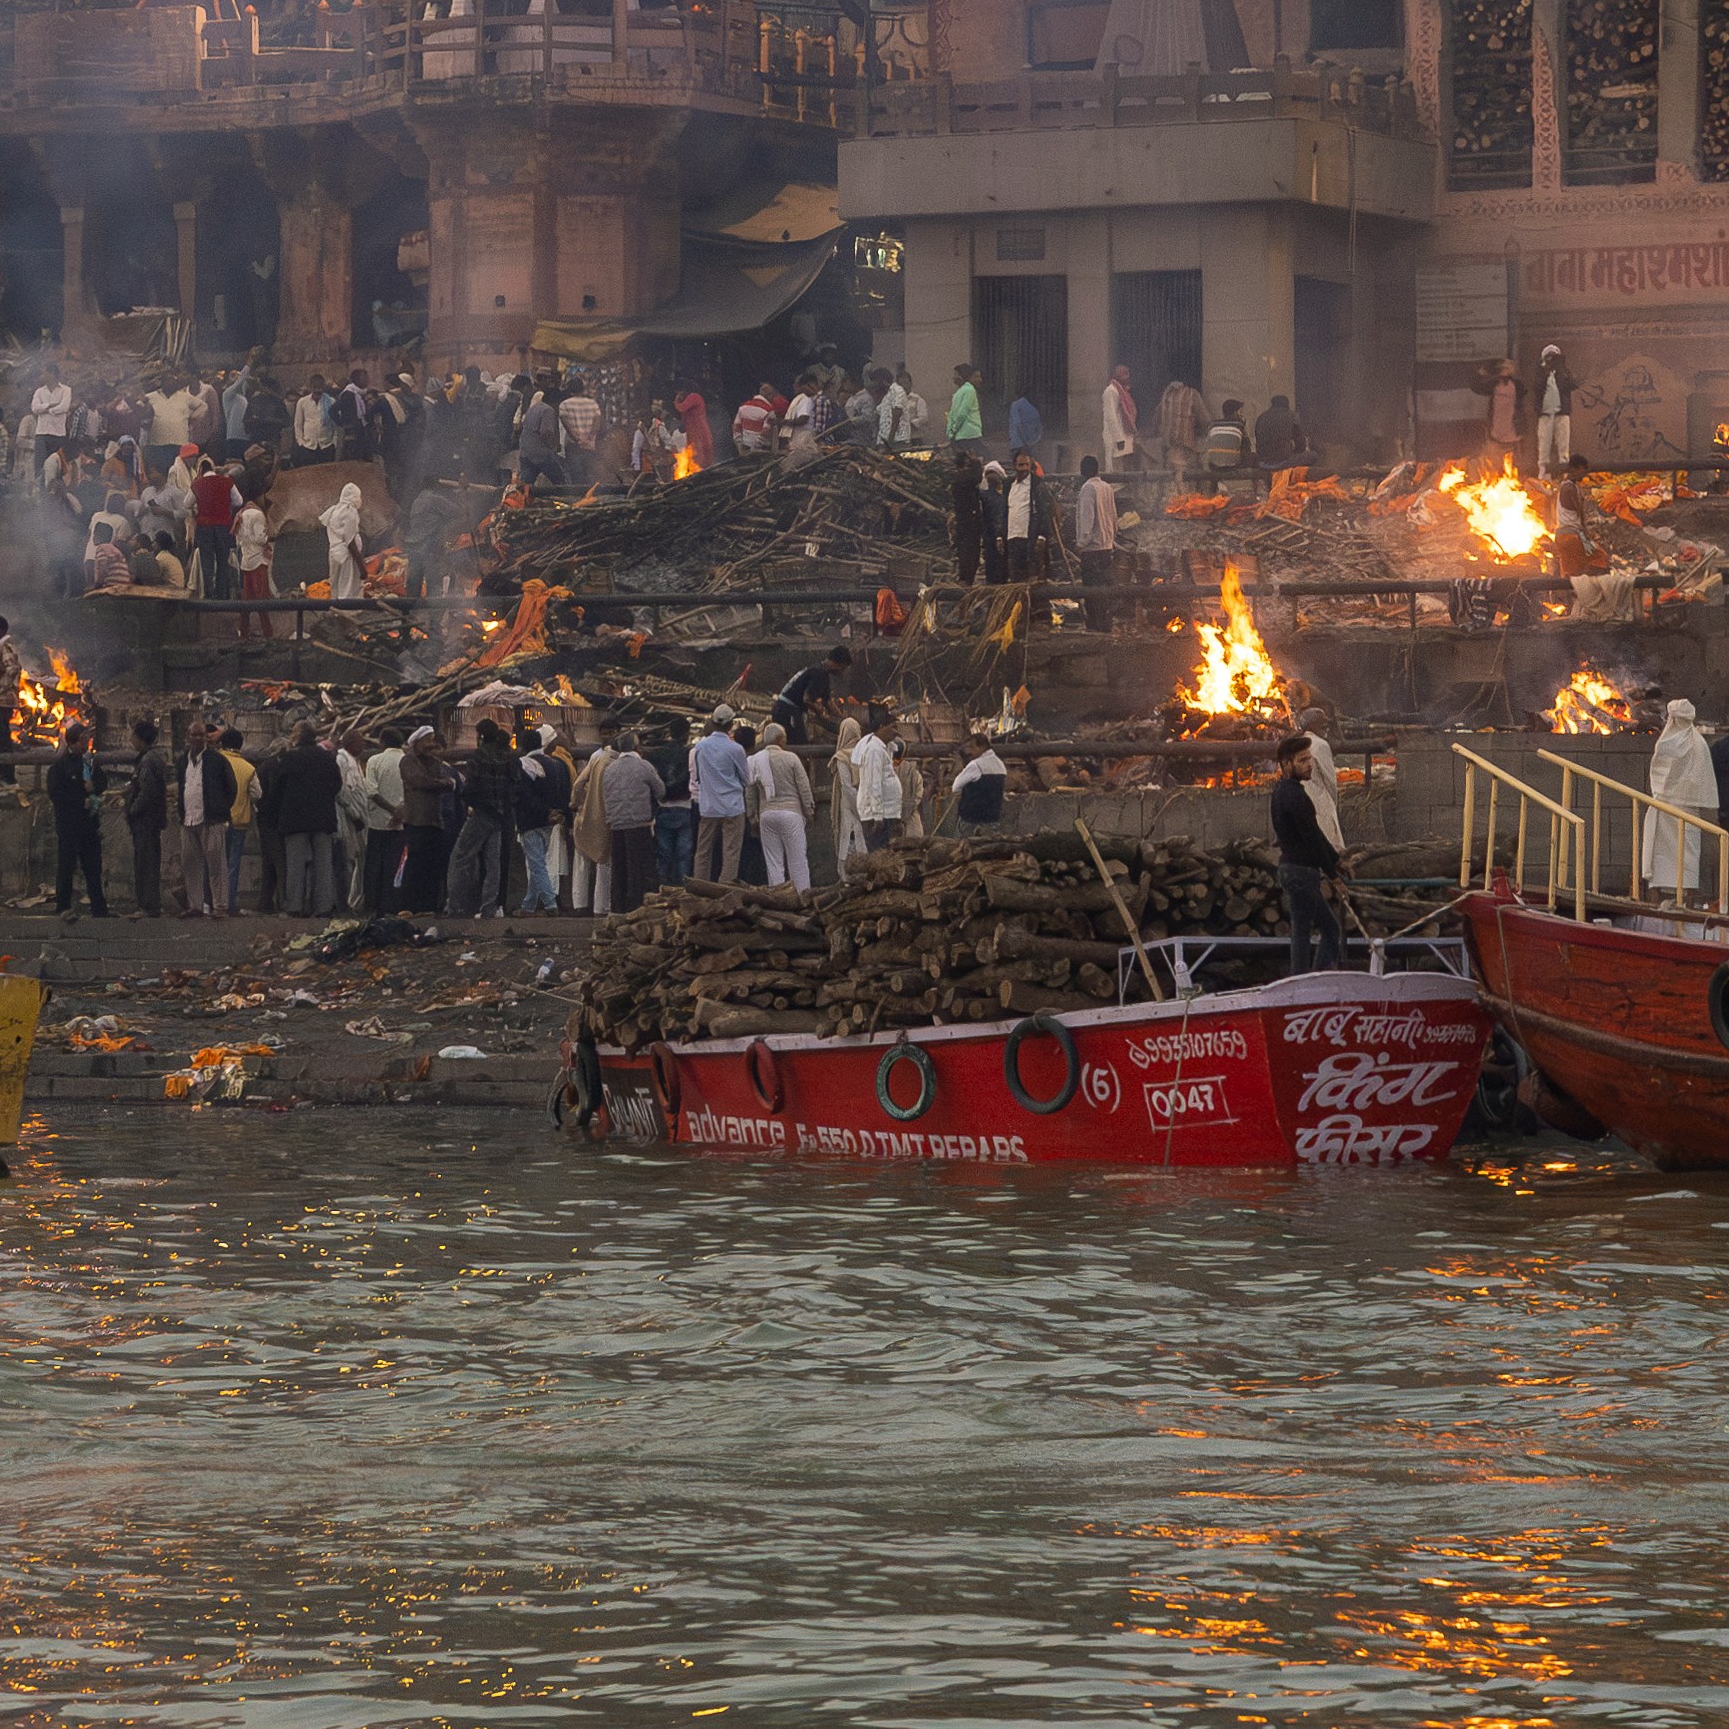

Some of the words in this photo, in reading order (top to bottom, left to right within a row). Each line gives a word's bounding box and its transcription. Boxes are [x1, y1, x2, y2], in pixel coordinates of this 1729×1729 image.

[1284, 1006, 1364, 1046] बाबू
[1143, 1030, 1248, 1063] 9935107659
[1151, 1084, 1214, 1117] 0047
[1298, 1052, 1460, 1112] किंग
[686, 1103, 786, 1146] advance
